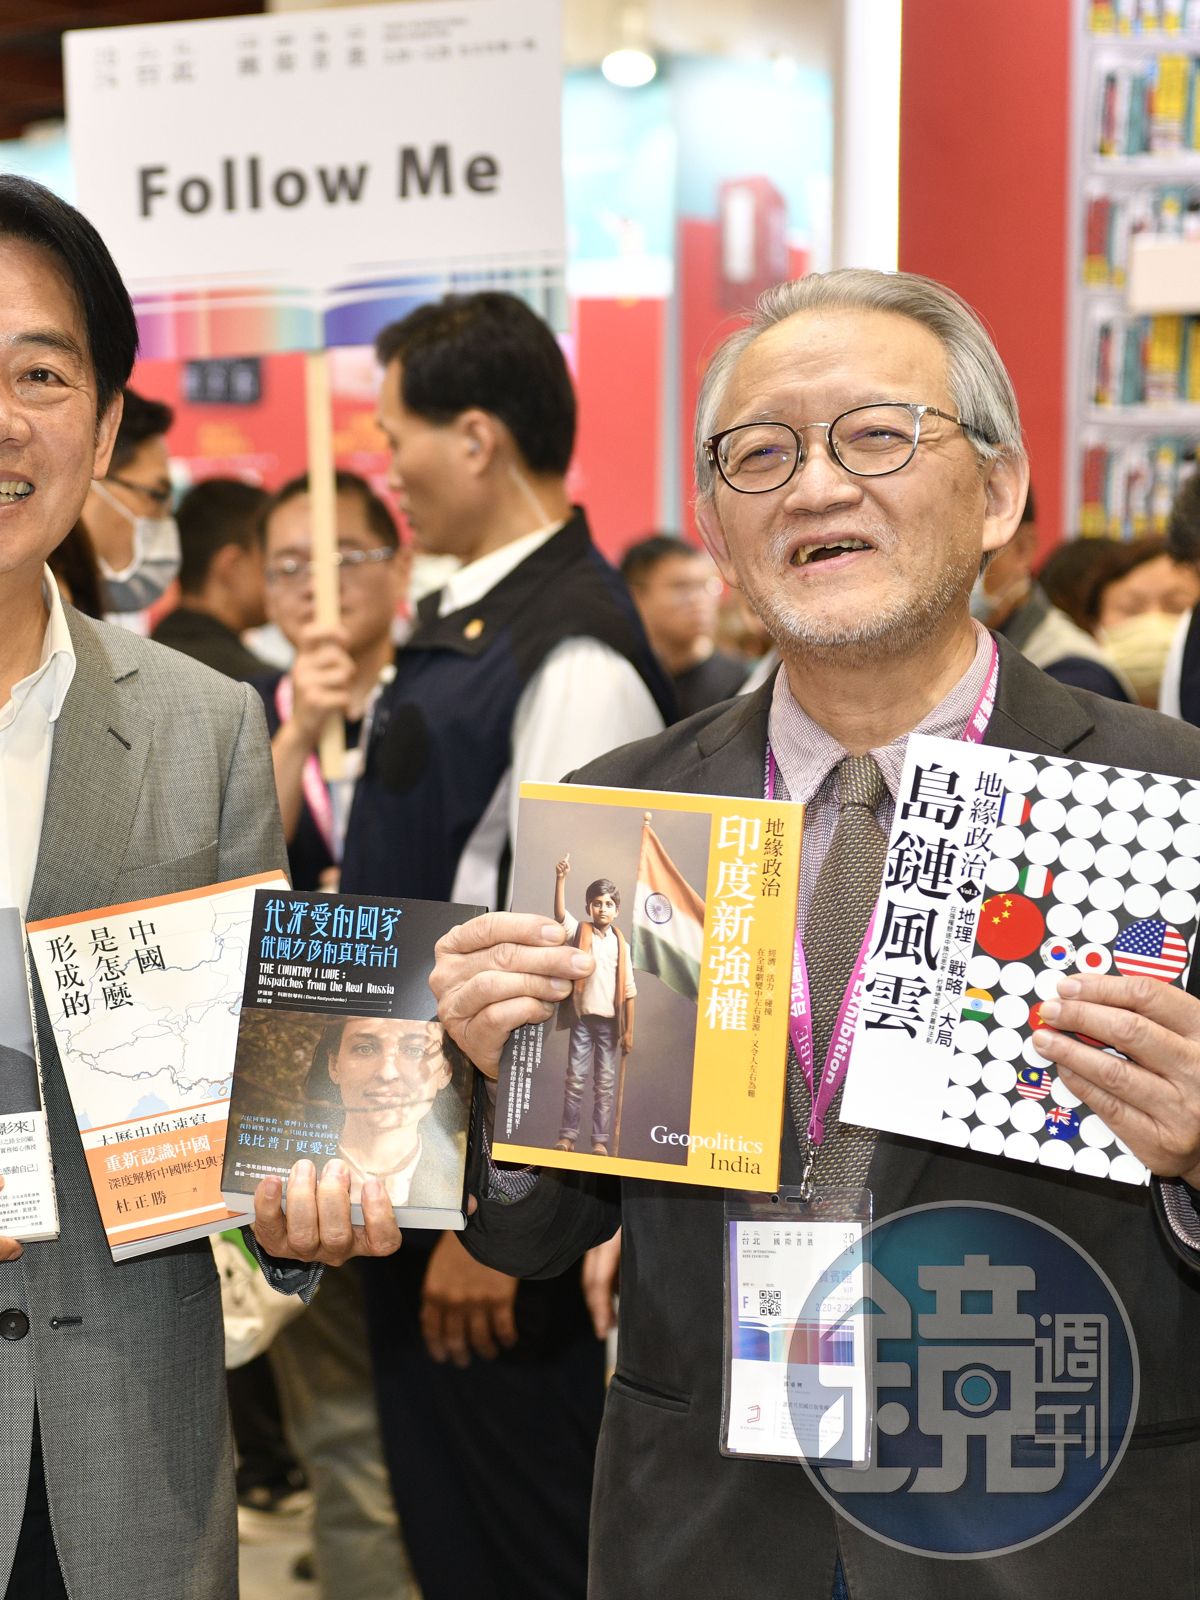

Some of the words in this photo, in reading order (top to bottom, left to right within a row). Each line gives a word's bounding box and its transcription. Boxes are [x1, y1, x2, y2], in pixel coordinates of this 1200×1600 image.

[138, 154, 368, 218] Follow
[398, 143, 501, 199] Me
[959, 770, 1004, 881] 地緣政治
[761, 817, 785, 898] 地緣政治
[863, 762, 966, 1041] 島鏈風雲
[704, 814, 761, 1032] 印度新強權
[954, 907, 975, 943] 地理
[128, 920, 166, 974] 中國
[46, 934, 90, 1019] 形成的
[88, 926, 135, 1009] 是怎麼
[258, 974, 304, 989] Dispatches
[307, 979, 326, 992] from
[329, 980, 343, 993] the
[345, 981, 363, 993] Real
[366, 983, 395, 995] Russia
[259, 962, 274, 974] THE
[277, 964, 312, 978] COUNTRY
[945, 959, 967, 996] 戰略
[935, 1012, 956, 1048] 大局
[104, 1135, 211, 1173] 重新認識中國
[238, 1133, 337, 1156] 我比普丁更愛它
[650, 1124, 763, 1156] Geopolitics
[709, 1152, 761, 1176] India
[116, 1190, 166, 1214] 杜正勝
[742, 1296, 749, 1309] F
